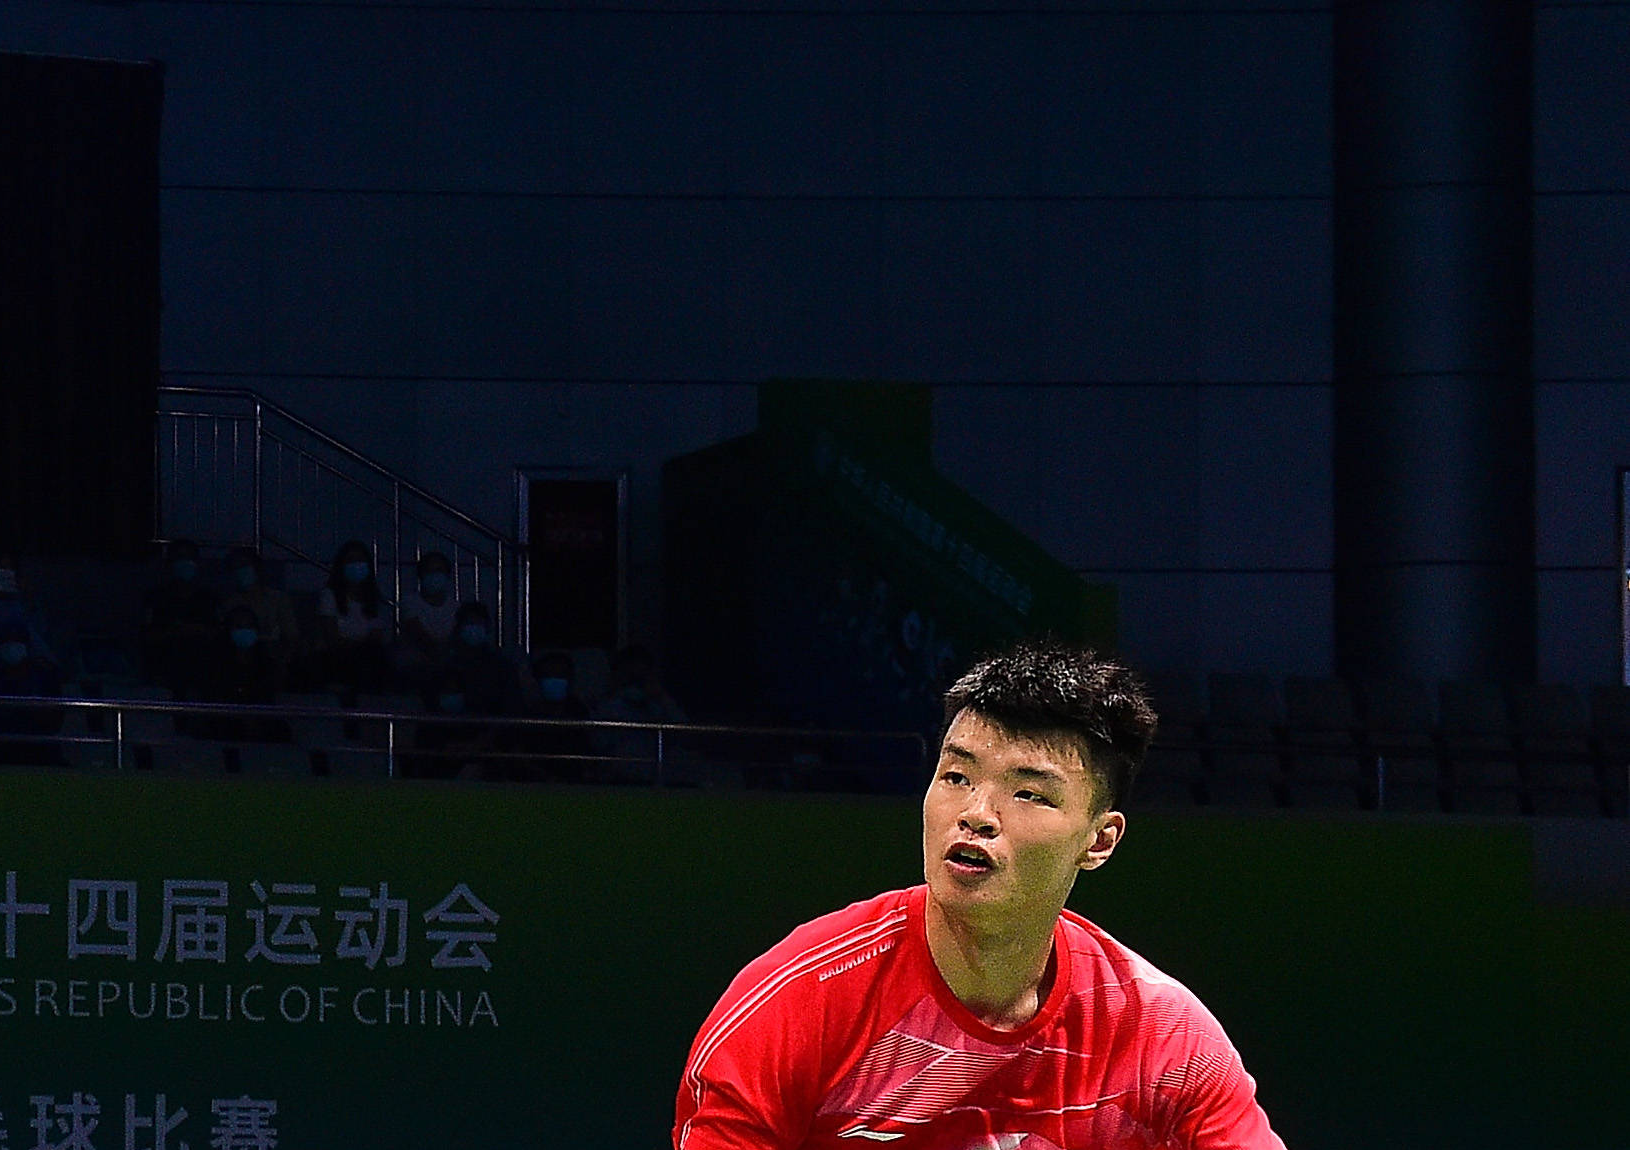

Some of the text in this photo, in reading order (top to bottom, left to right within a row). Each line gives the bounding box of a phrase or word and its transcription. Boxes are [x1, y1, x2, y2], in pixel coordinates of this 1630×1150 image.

[33, 979, 266, 1023] REPUBLIC
[279, 985, 341, 1024] OF
[352, 987, 499, 1028] CHINA
